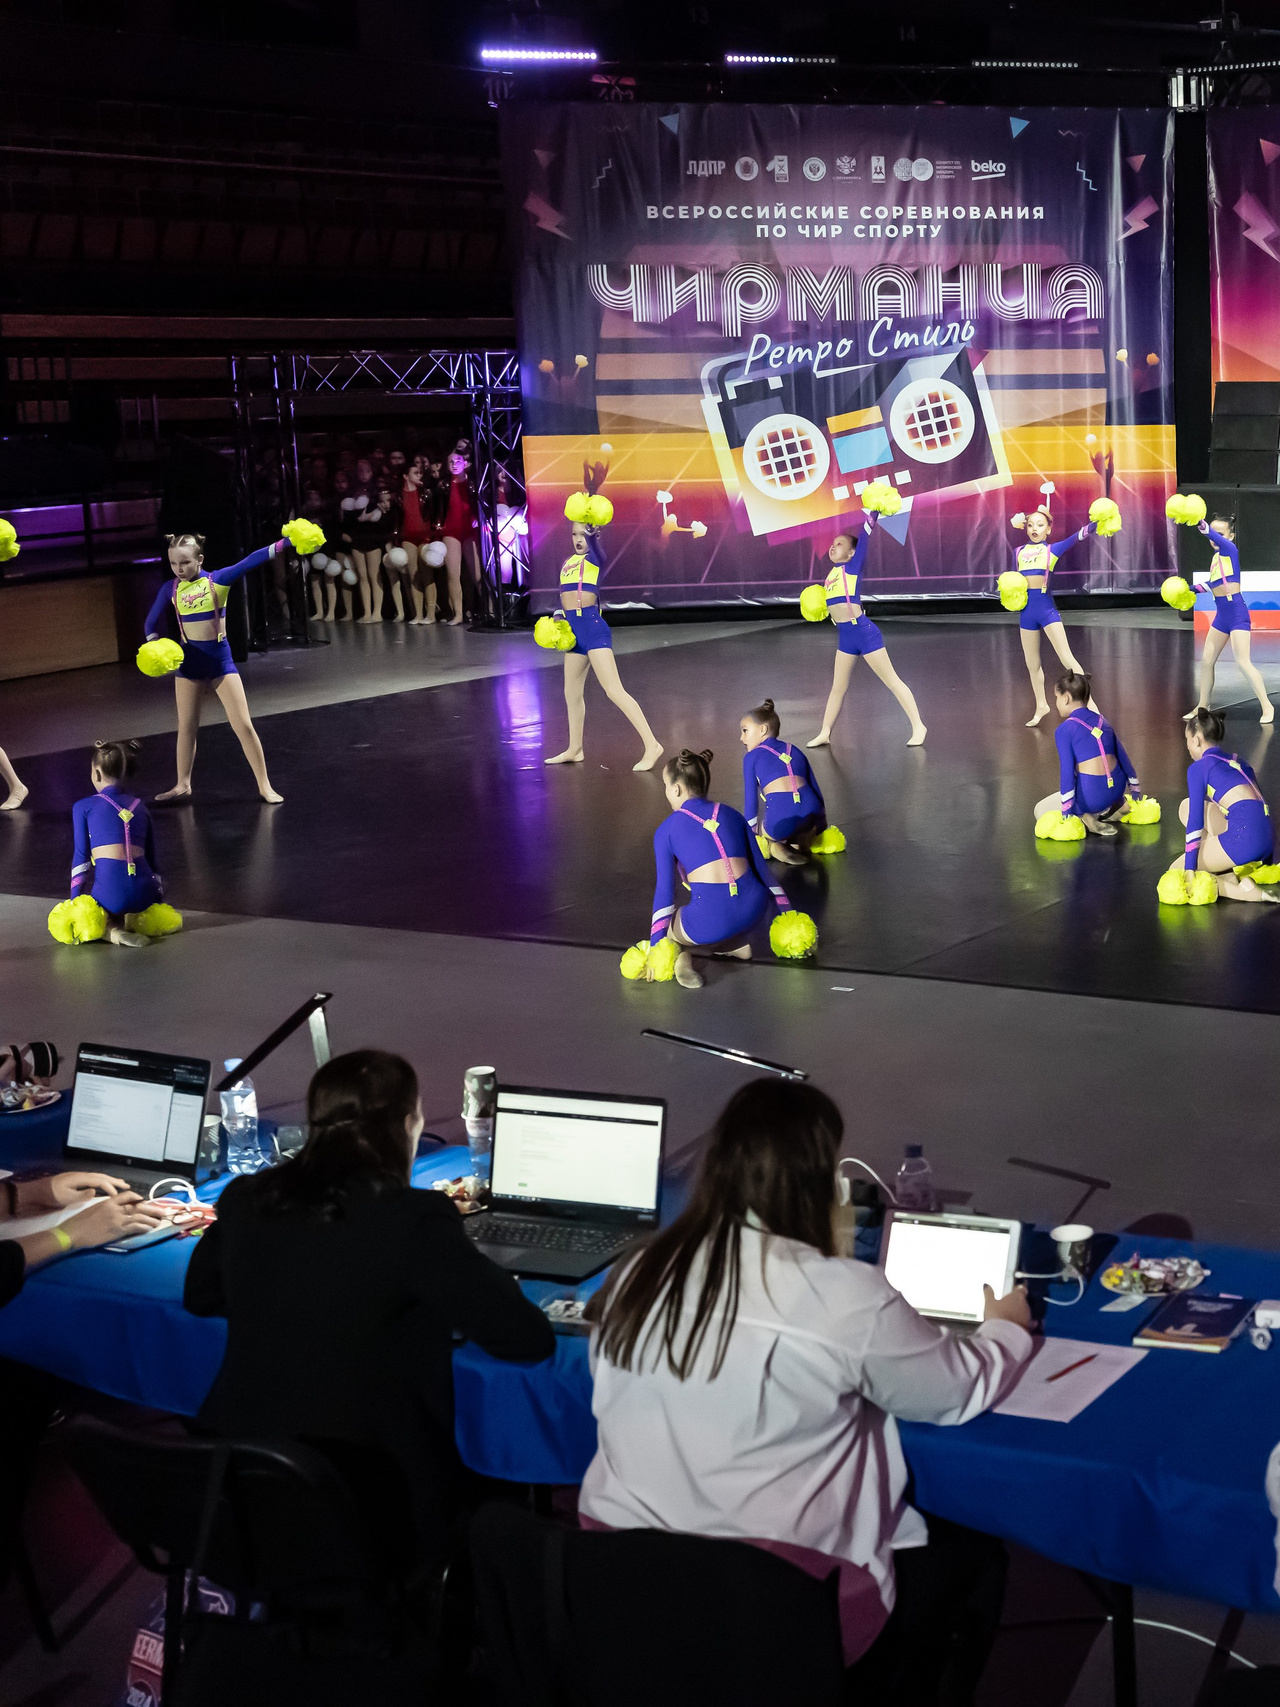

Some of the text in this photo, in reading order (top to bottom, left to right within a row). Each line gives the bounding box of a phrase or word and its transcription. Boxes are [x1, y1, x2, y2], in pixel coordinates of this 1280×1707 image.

[686, 160, 726, 177] ЛДПР
[971, 159, 1006, 173] beko
[646, 203, 1044, 219] ВСЕРОССИЙСКИЕ СОРЕВНОВАНИЯ
[756, 224, 942, 238] ПО ЧИР СПОРТУ
[744, 316, 975, 376] Ретро Стиль
